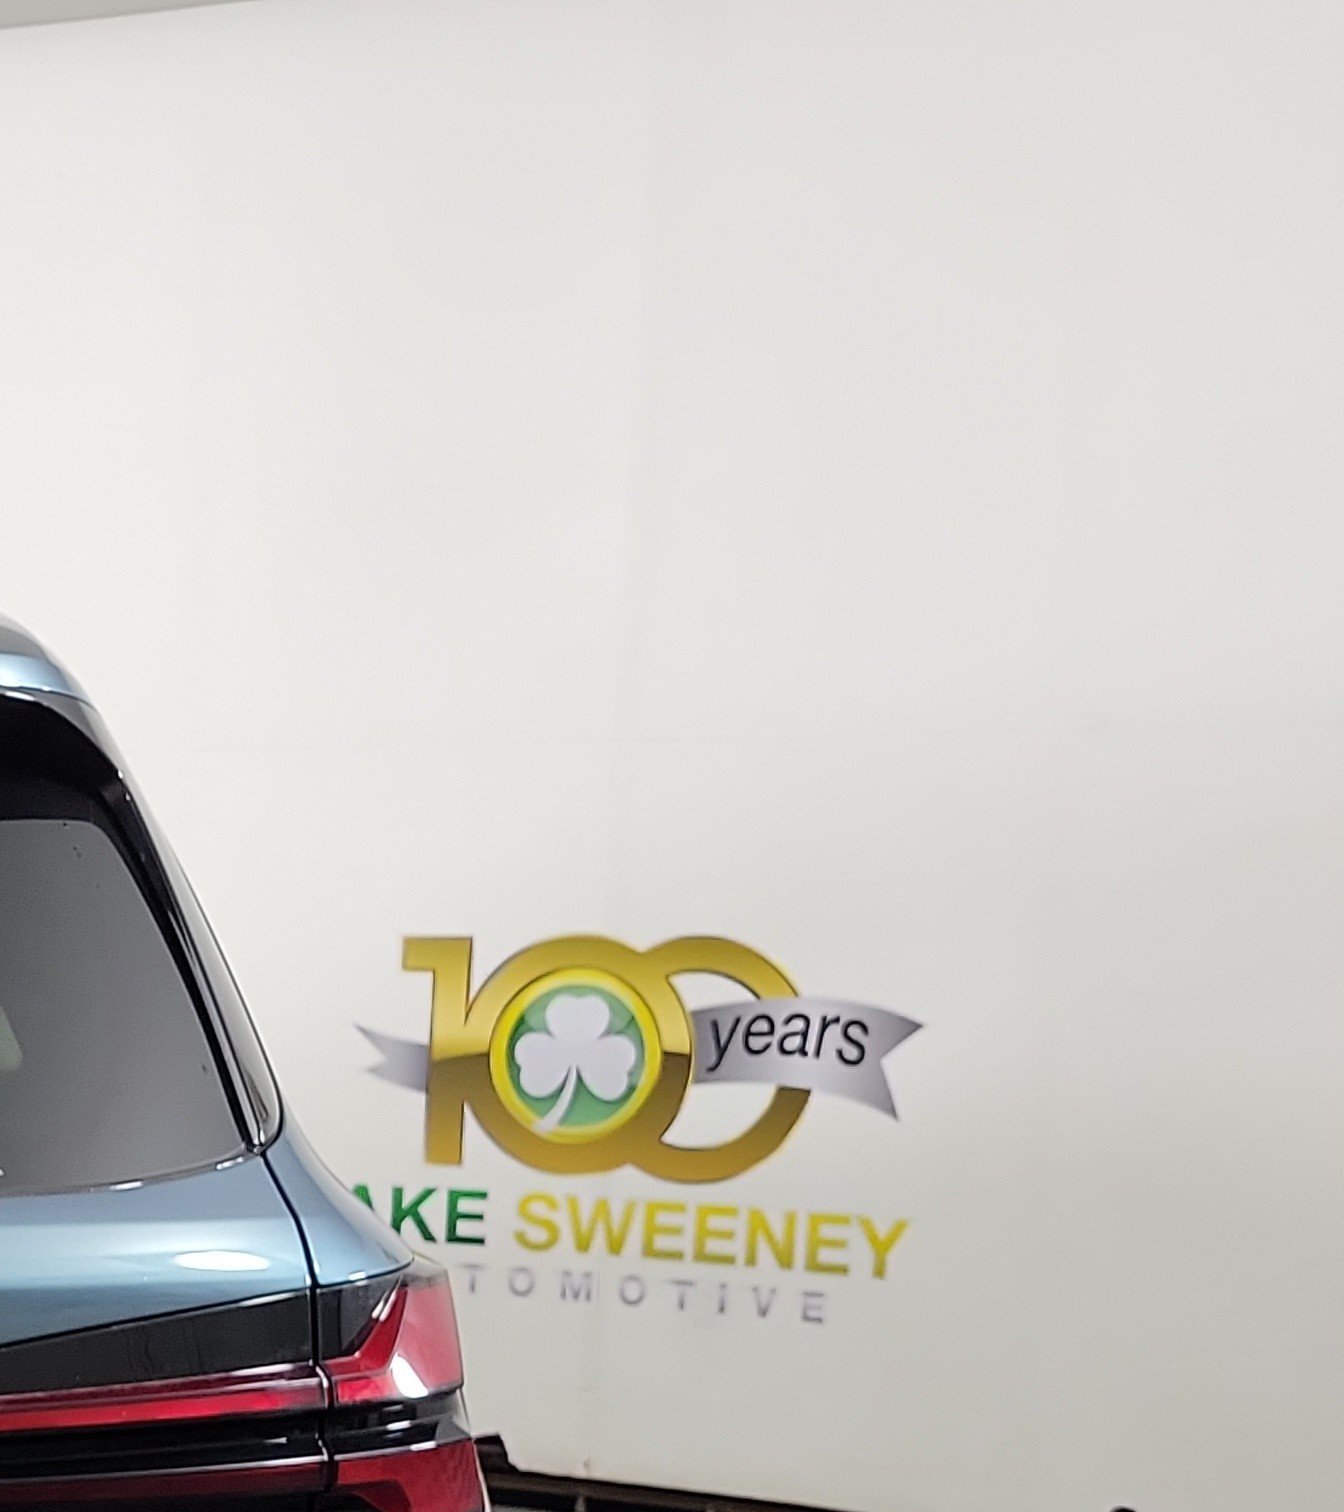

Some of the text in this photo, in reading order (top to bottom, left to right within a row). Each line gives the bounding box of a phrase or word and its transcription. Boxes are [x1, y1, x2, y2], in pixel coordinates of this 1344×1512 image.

[706, 1011, 871, 1072] years
[352, 1183, 910, 1280] KE SWEENEY
[463, 1262, 828, 1325] TOMOTIVE
